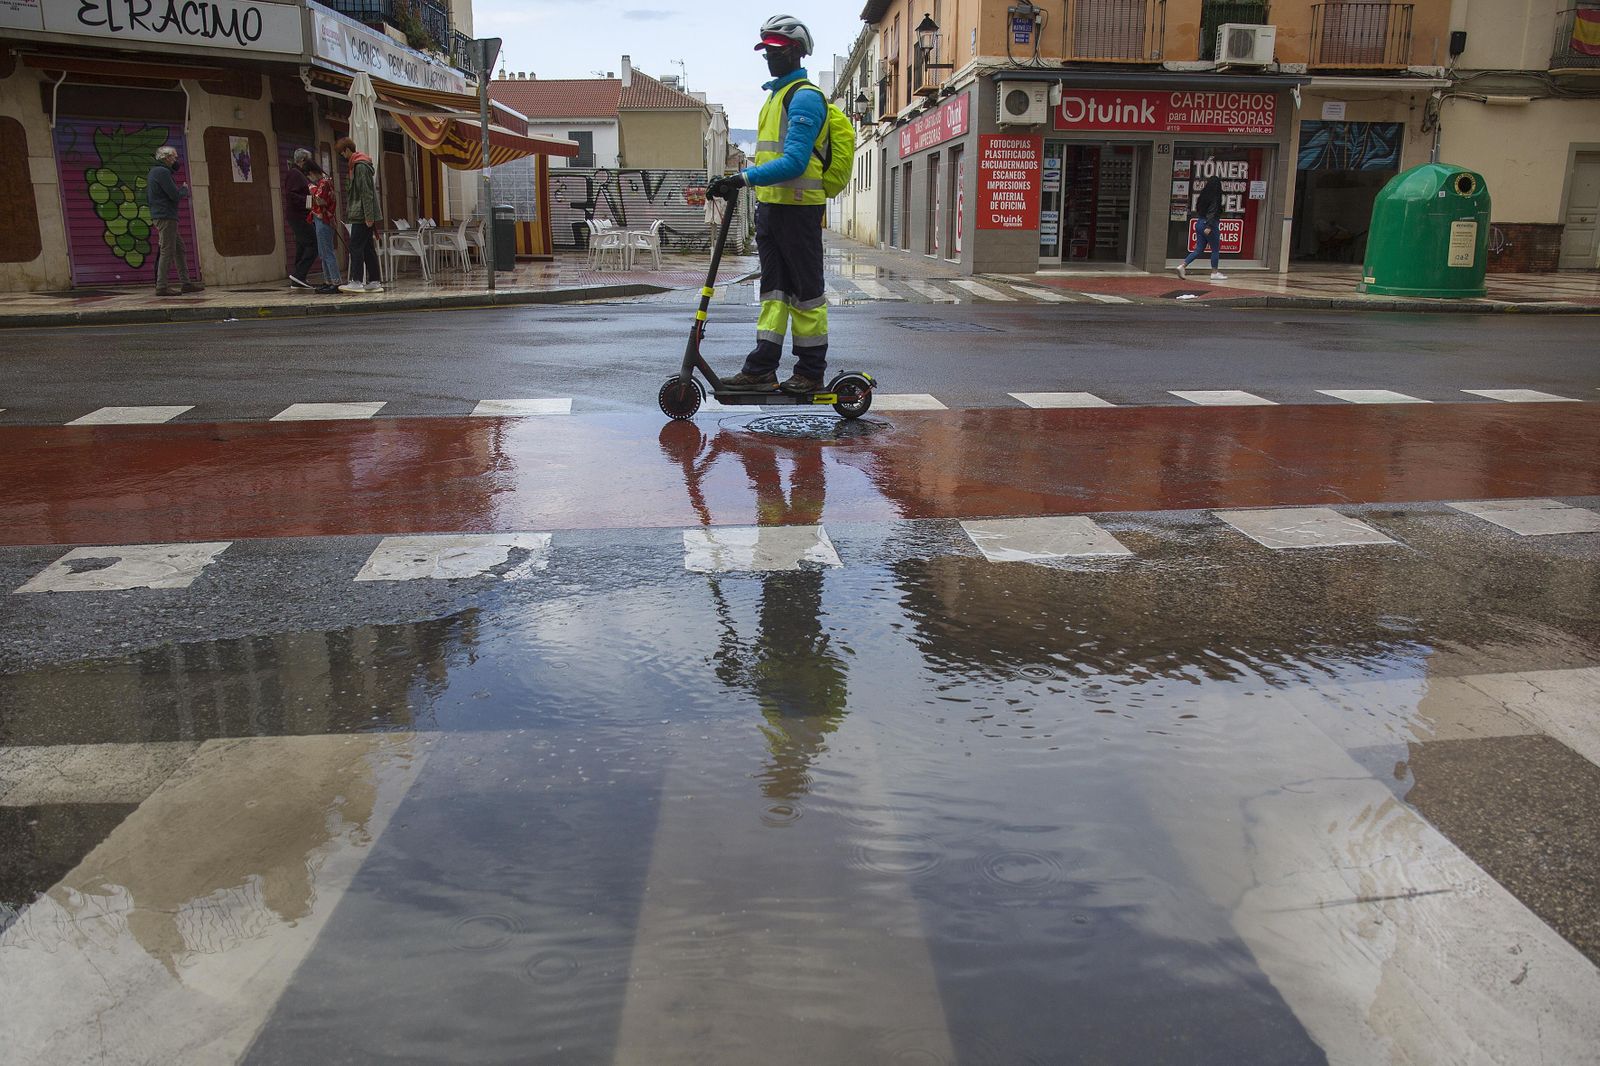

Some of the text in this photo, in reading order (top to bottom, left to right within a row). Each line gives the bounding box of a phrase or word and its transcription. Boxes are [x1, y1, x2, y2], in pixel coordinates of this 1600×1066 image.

[124, 0, 263, 46] RACIMO
[351, 37, 382, 70] CARNES
[387, 53, 419, 85] PESCADOS
[1170, 92, 1274, 111] CARTUCHOS
[1168, 109, 1273, 125] para IMPRESORAS
[1228, 126, 1273, 134] www.tuink.es
[990, 139, 1031, 149] FOTOCOPIAS
[1158, 144, 1169, 154] 48
[984, 150, 1036, 159] PLASTIFICADOS
[981, 160, 1038, 170] ENCUADERNADOS
[1193, 156, 1248, 179] TÓNER
[992, 170, 1026, 180] ESCANEOS
[987, 180, 1031, 190] IMPRESIONES
[992, 191, 1024, 201] MATERIAL
[990, 201, 1026, 210] DE OFICINA
